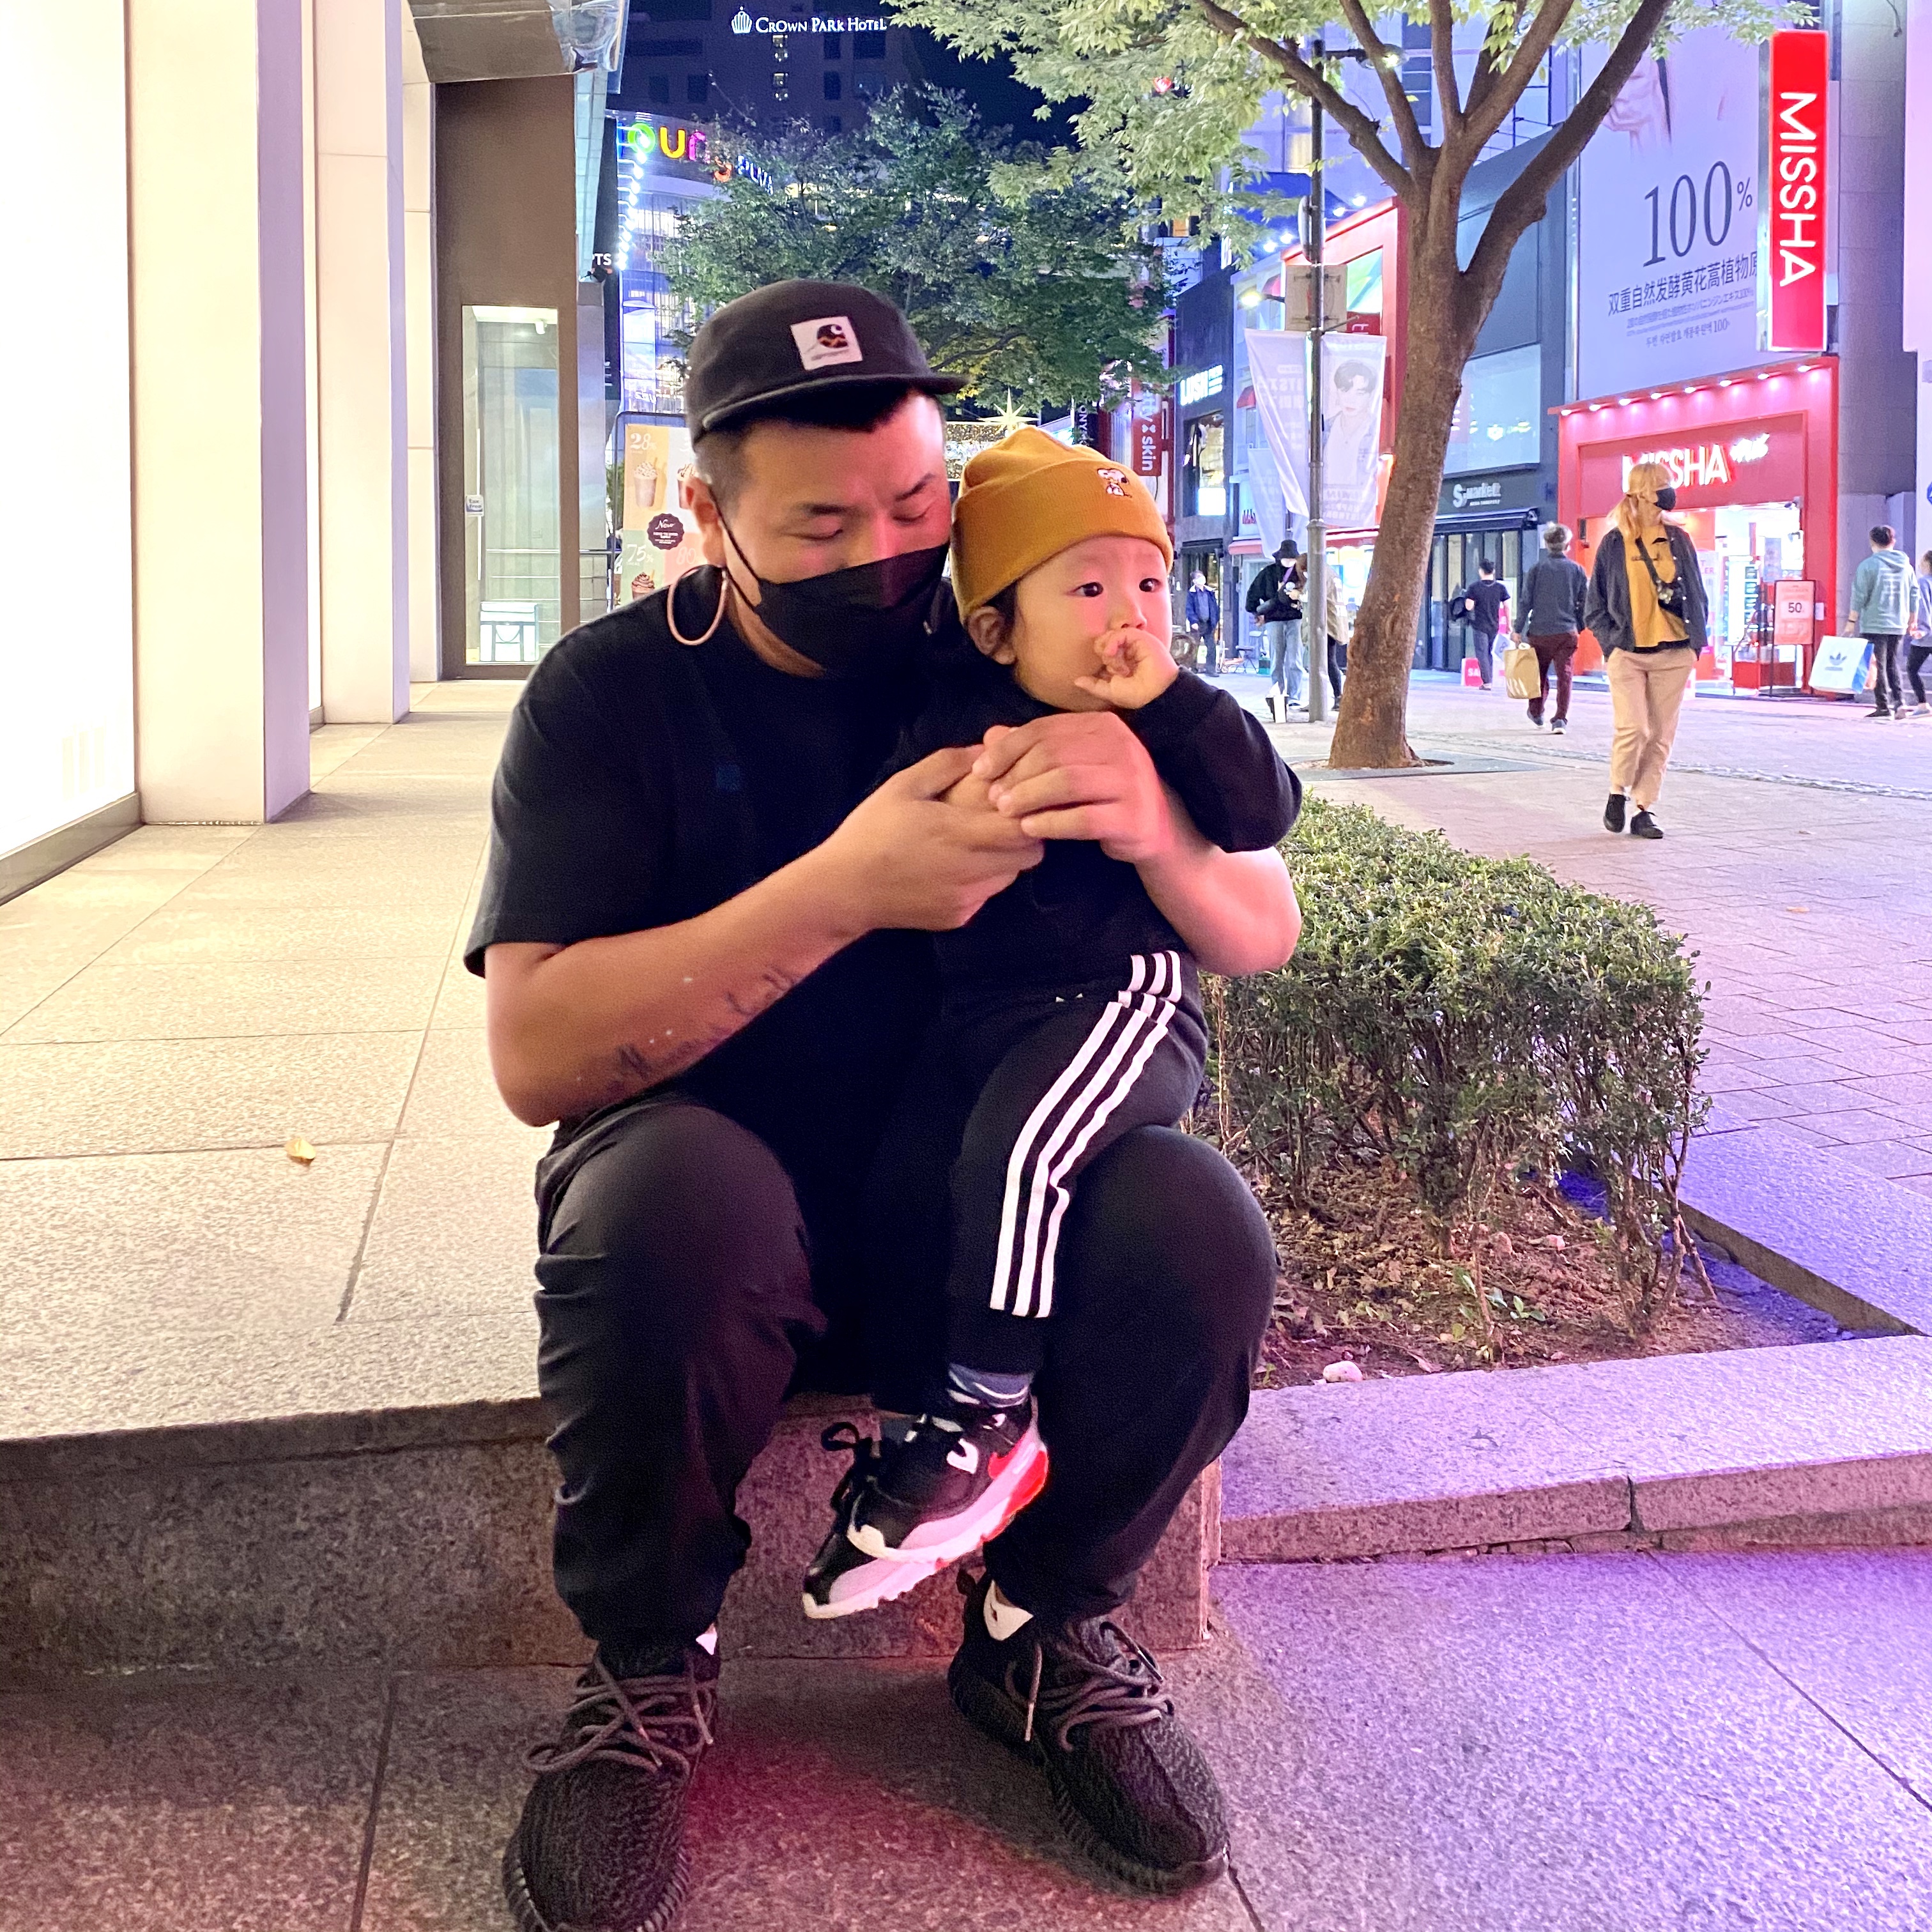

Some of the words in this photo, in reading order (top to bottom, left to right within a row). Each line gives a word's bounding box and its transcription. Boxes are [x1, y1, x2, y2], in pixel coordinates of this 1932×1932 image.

[755, 17, 808, 32] CROWN
[811, 17, 845, 32] PARK
[847, 17, 887, 31] HOTEL
[1643, 160, 1753, 267] 100%
[1779, 92, 1817, 287] MISSHA
[1141, 436, 1156, 471] skin
[1621, 443, 1729, 493] MSHA
